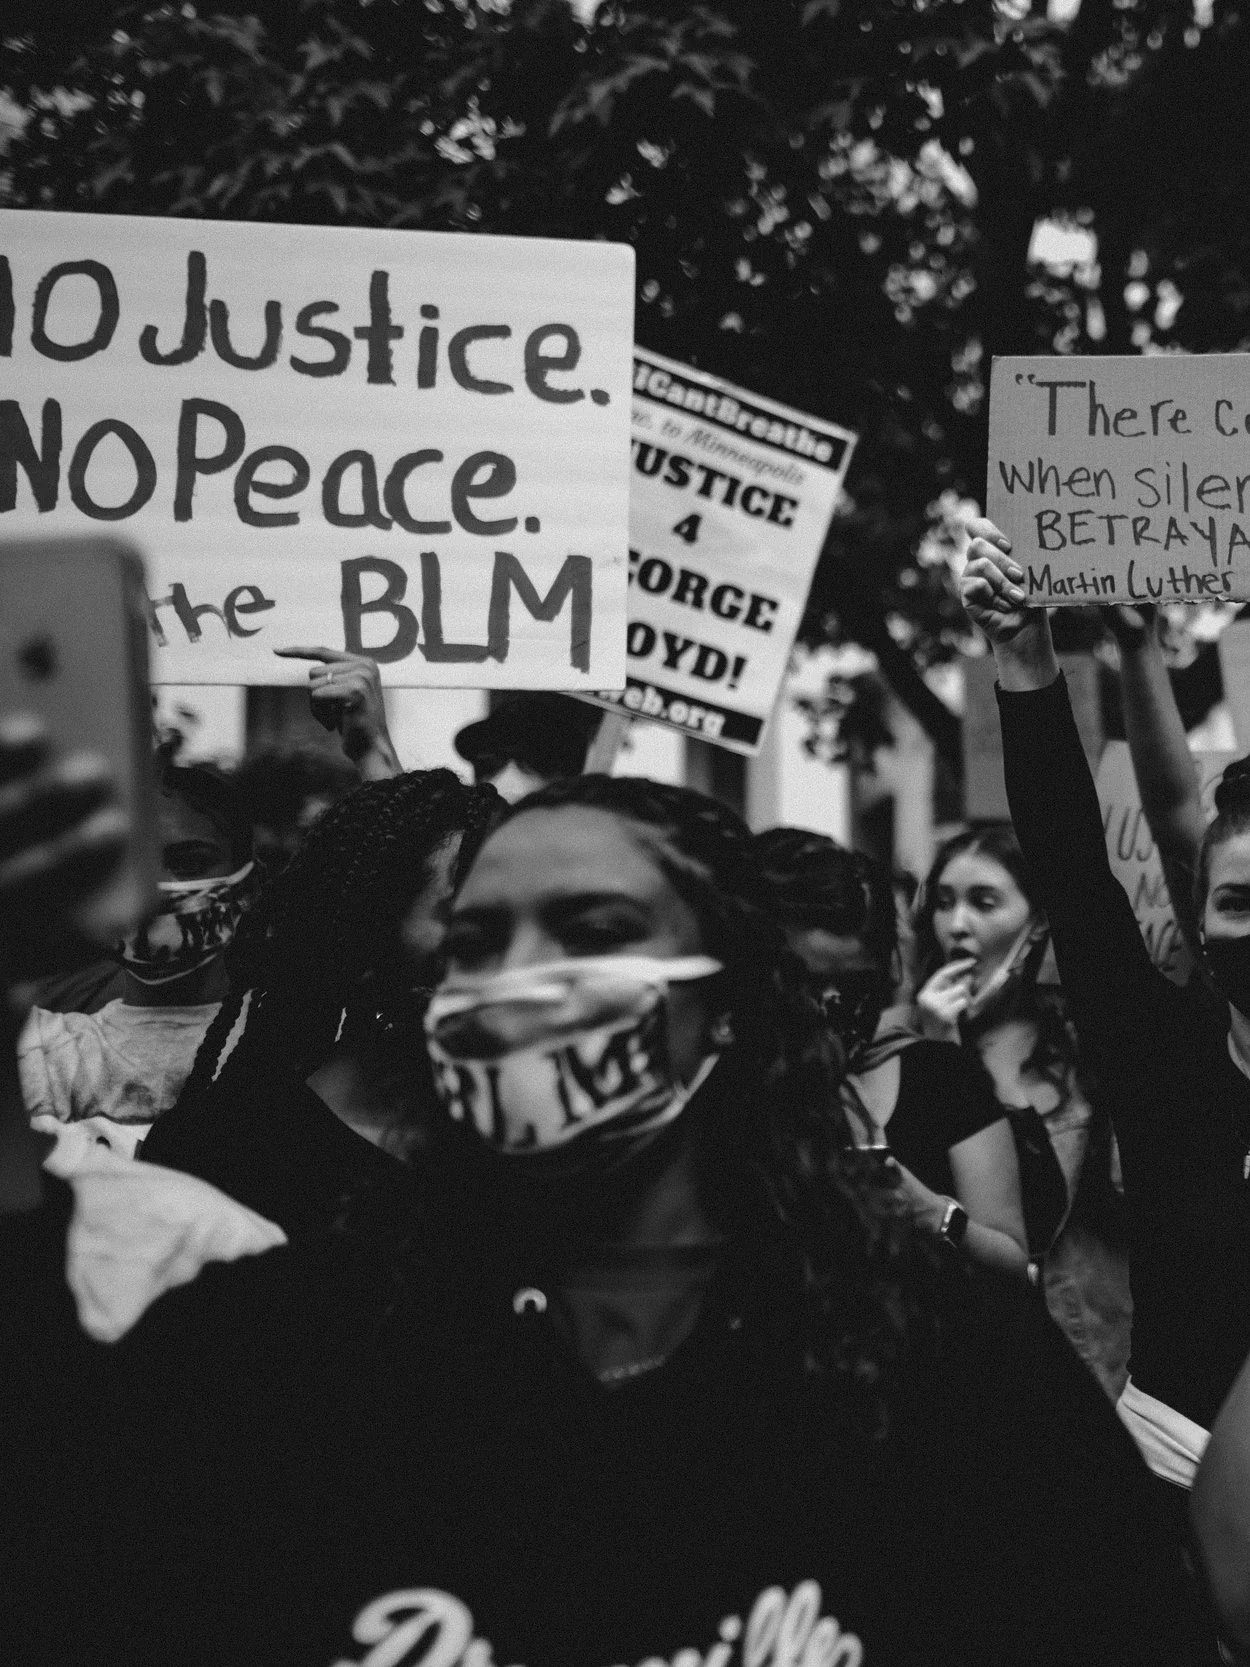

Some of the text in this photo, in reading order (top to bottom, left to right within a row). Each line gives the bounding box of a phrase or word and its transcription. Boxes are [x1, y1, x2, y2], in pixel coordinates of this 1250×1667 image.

[139, 250, 611, 406] Justice.
[633, 362, 834, 463] ICantBreathe
[0, 397, 541, 537] NO Peace.
[632, 438, 800, 529] USTICE
[672, 512, 703, 545] 4
[340, 551, 593, 674] BLM
[629, 549, 780, 633] ORGE
[1027, 563, 1116, 597] Martin
[1127, 559, 1235, 599] Luther
[627, 621, 748, 691] OYD!
